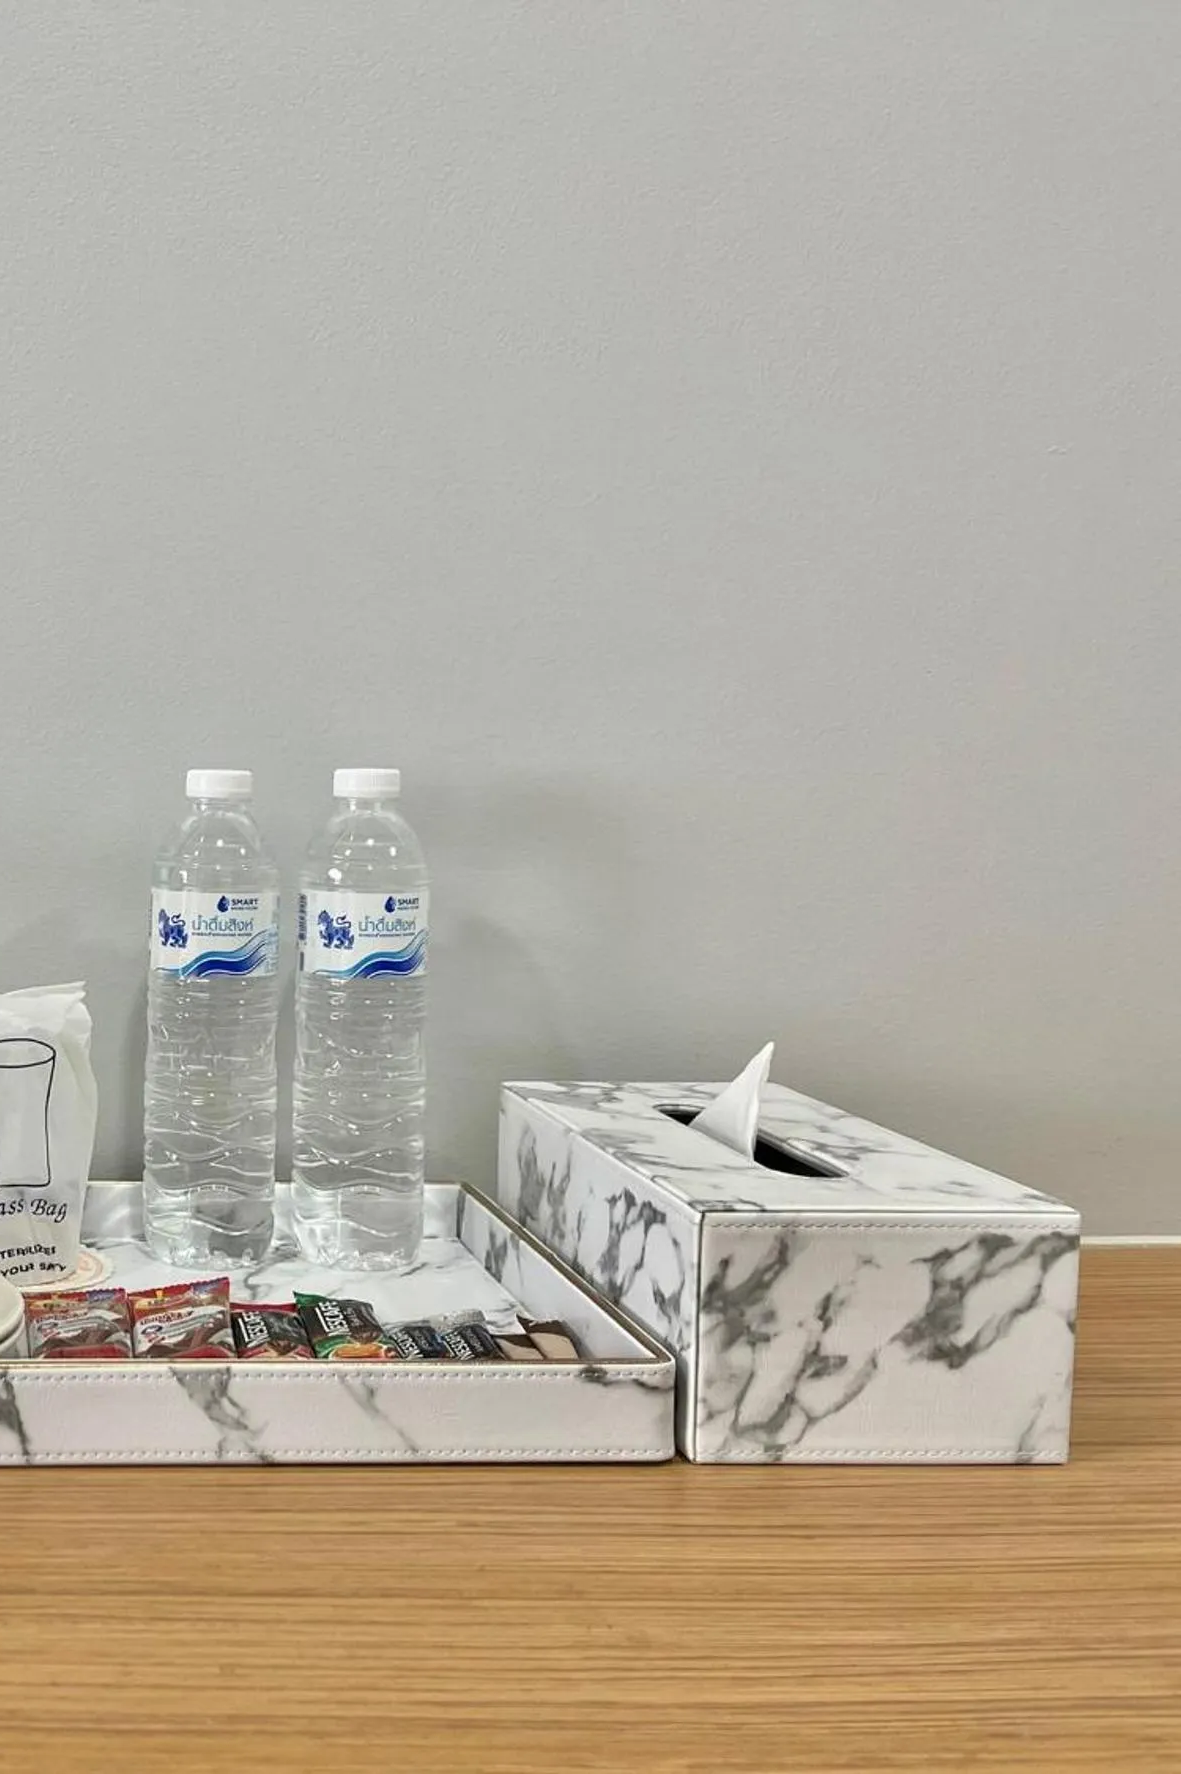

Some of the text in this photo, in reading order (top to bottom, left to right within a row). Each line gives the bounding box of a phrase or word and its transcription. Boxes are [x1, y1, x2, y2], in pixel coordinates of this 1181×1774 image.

[230, 898, 258, 906] SMART
[397, 897, 419, 906] SMART
[30, 1198, 67, 1224] Bag
